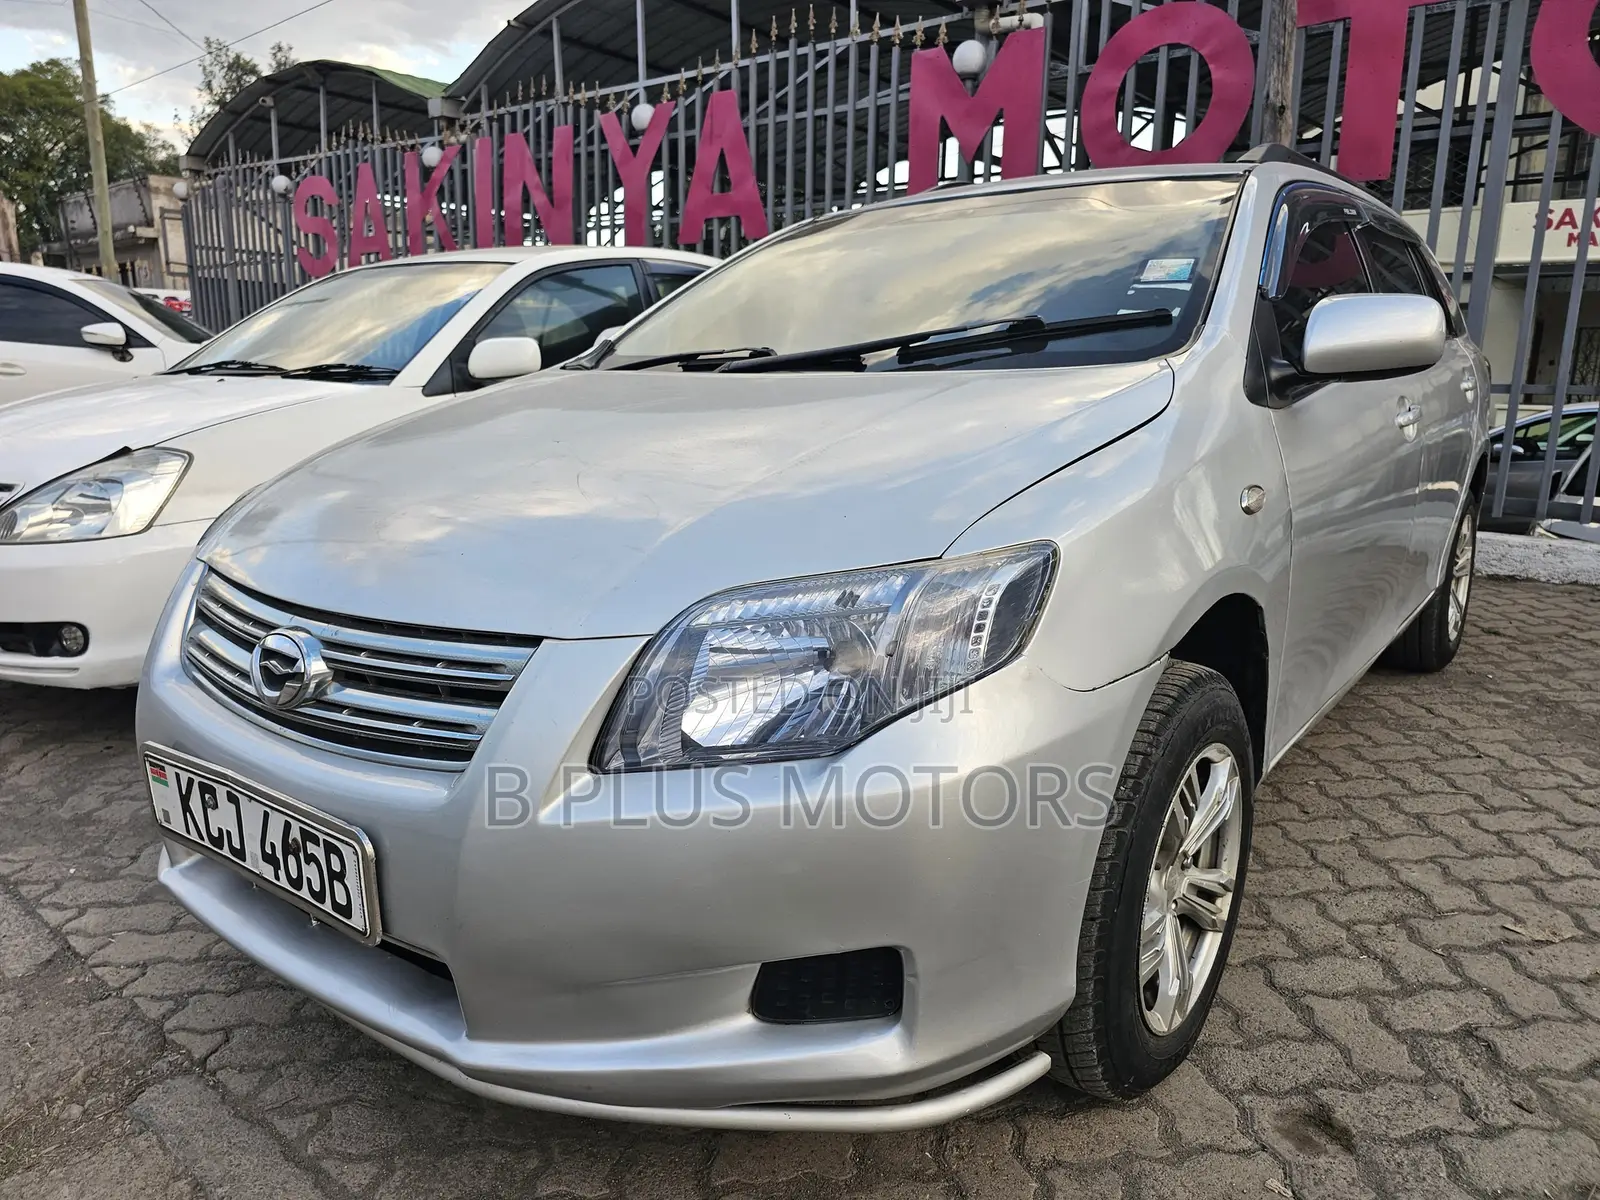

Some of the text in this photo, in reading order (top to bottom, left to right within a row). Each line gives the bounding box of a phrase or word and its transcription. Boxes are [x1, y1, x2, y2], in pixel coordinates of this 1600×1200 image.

[295, 90, 769, 279] SAKINYA
[175, 771, 247, 863] KCJ
[260, 809, 353, 920] 465B
